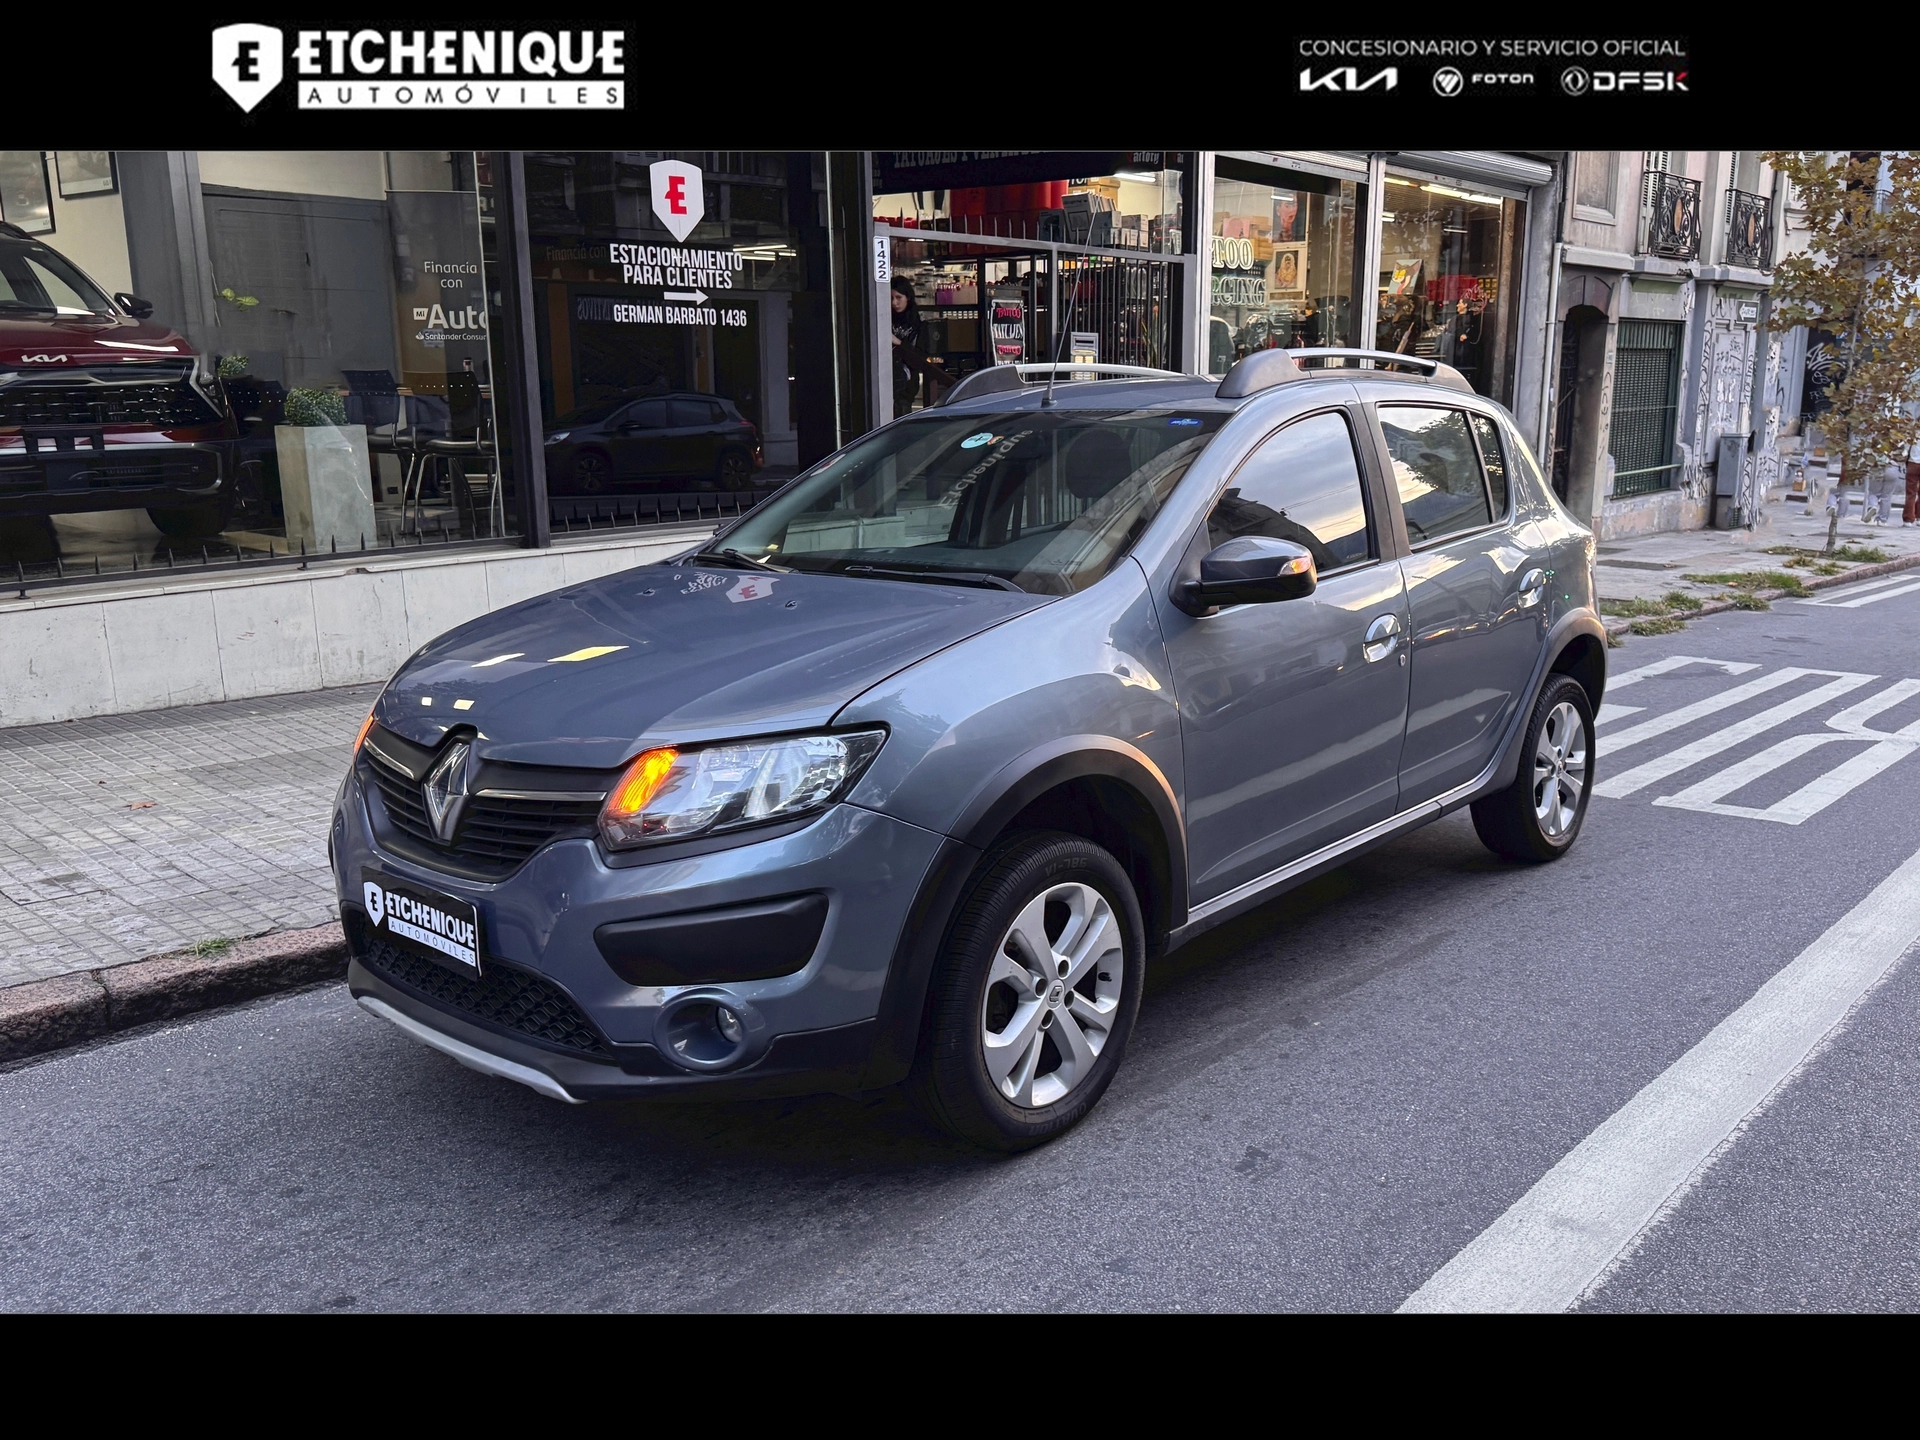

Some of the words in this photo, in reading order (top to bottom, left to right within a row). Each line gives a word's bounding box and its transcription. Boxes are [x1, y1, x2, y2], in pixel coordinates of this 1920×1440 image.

[609, 243, 743, 271] ESTACIONAMIENTO
[440, 278, 463, 289] con
[623, 264, 664, 286] PARA
[666, 266, 733, 289] CLIENTES
[613, 304, 663, 324] GERMAN
[665, 306, 717, 326] BARBATO
[720, 308, 748, 327] 1436
[424, 332, 462, 341] Santander
[21, 353, 68, 363] KIA
[384, 890, 475, 949] ETCHENIQUE
